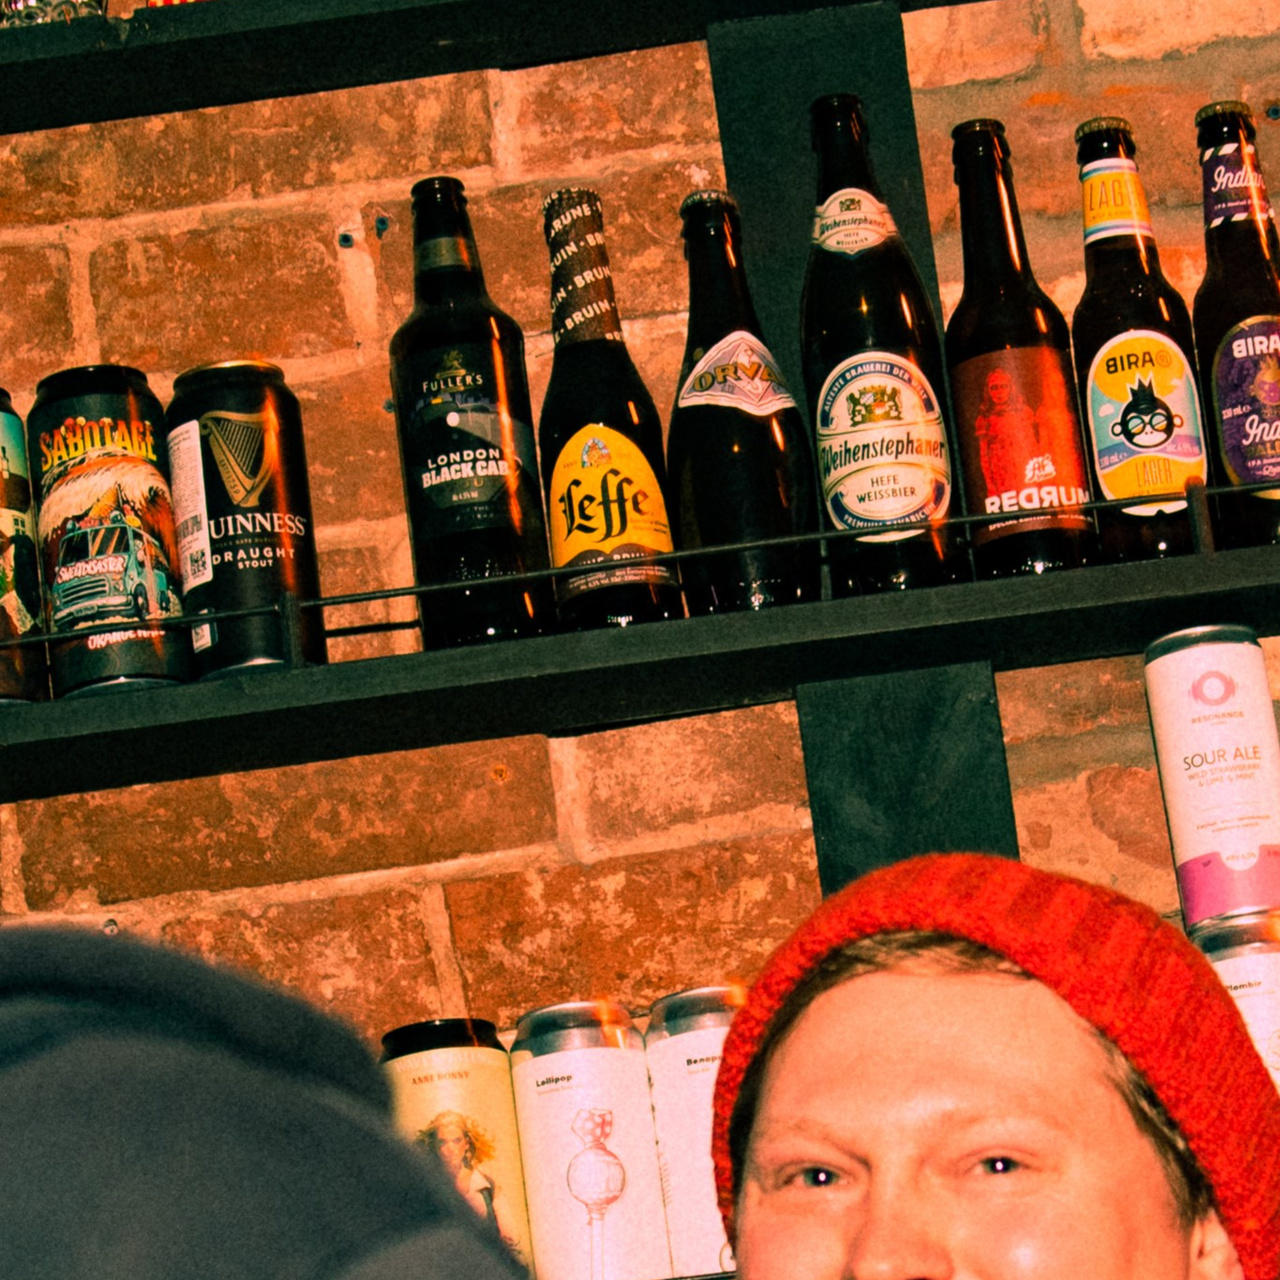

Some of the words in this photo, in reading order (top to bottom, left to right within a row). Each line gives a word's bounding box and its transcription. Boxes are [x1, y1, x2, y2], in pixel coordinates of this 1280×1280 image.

[1105, 350, 1156, 375] BIRA
[422, 372, 484, 394] FULLER'S
[692, 362, 782, 393] ORVA
[39, 418, 157, 472] SABOTAGE
[821, 431, 945, 478] Weihenstephaner
[427, 447, 500, 469] LONDON
[421, 461, 475, 489] BLACK
[476, 459, 510, 477] CAB
[870, 474, 900, 488] HEFE
[1136, 457, 1173, 488] LAGER
[557, 467, 650, 544] Leffe
[856, 486, 918, 505] WEISSBIER
[209, 512, 306, 540] UINNESS
[212, 546, 296, 566] DRAUGHT
[238, 558, 274, 570] STOUT
[1191, 710, 1245, 724] RESONANCE
[1183, 748, 1228, 771] SOUR
[1233, 744, 1262, 762] ALE
[411, 1073, 435, 1086] ANNE
[437, 1070, 470, 1082] BONNY
[535, 1074, 573, 1088] Lollipop
